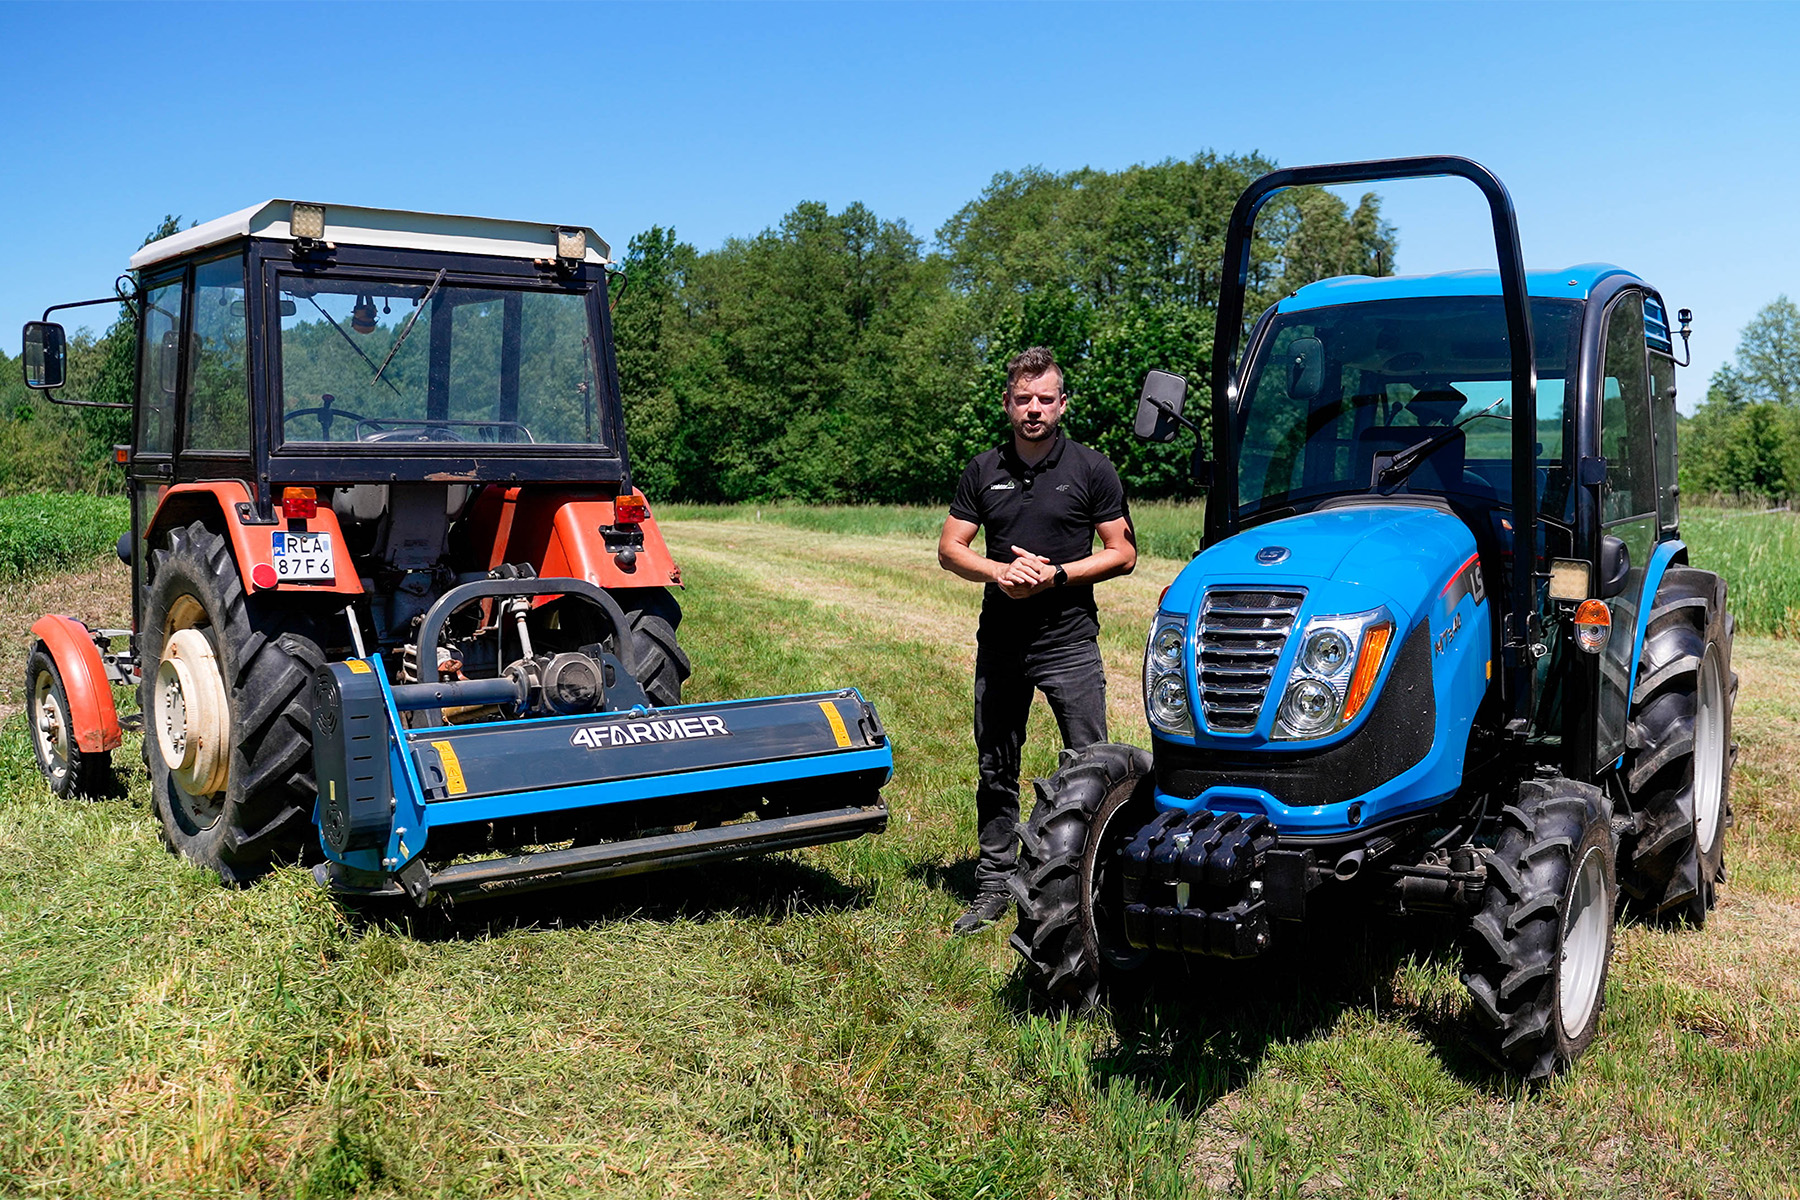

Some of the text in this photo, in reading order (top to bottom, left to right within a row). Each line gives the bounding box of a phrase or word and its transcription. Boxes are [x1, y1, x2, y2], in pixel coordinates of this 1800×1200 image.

[274, 546, 285, 555] PL
[287, 537, 323, 553] RLA
[278, 558, 330, 575] 87F6
[1469, 566, 1485, 603] LS
[572, 715, 729, 748] 4FARMER
